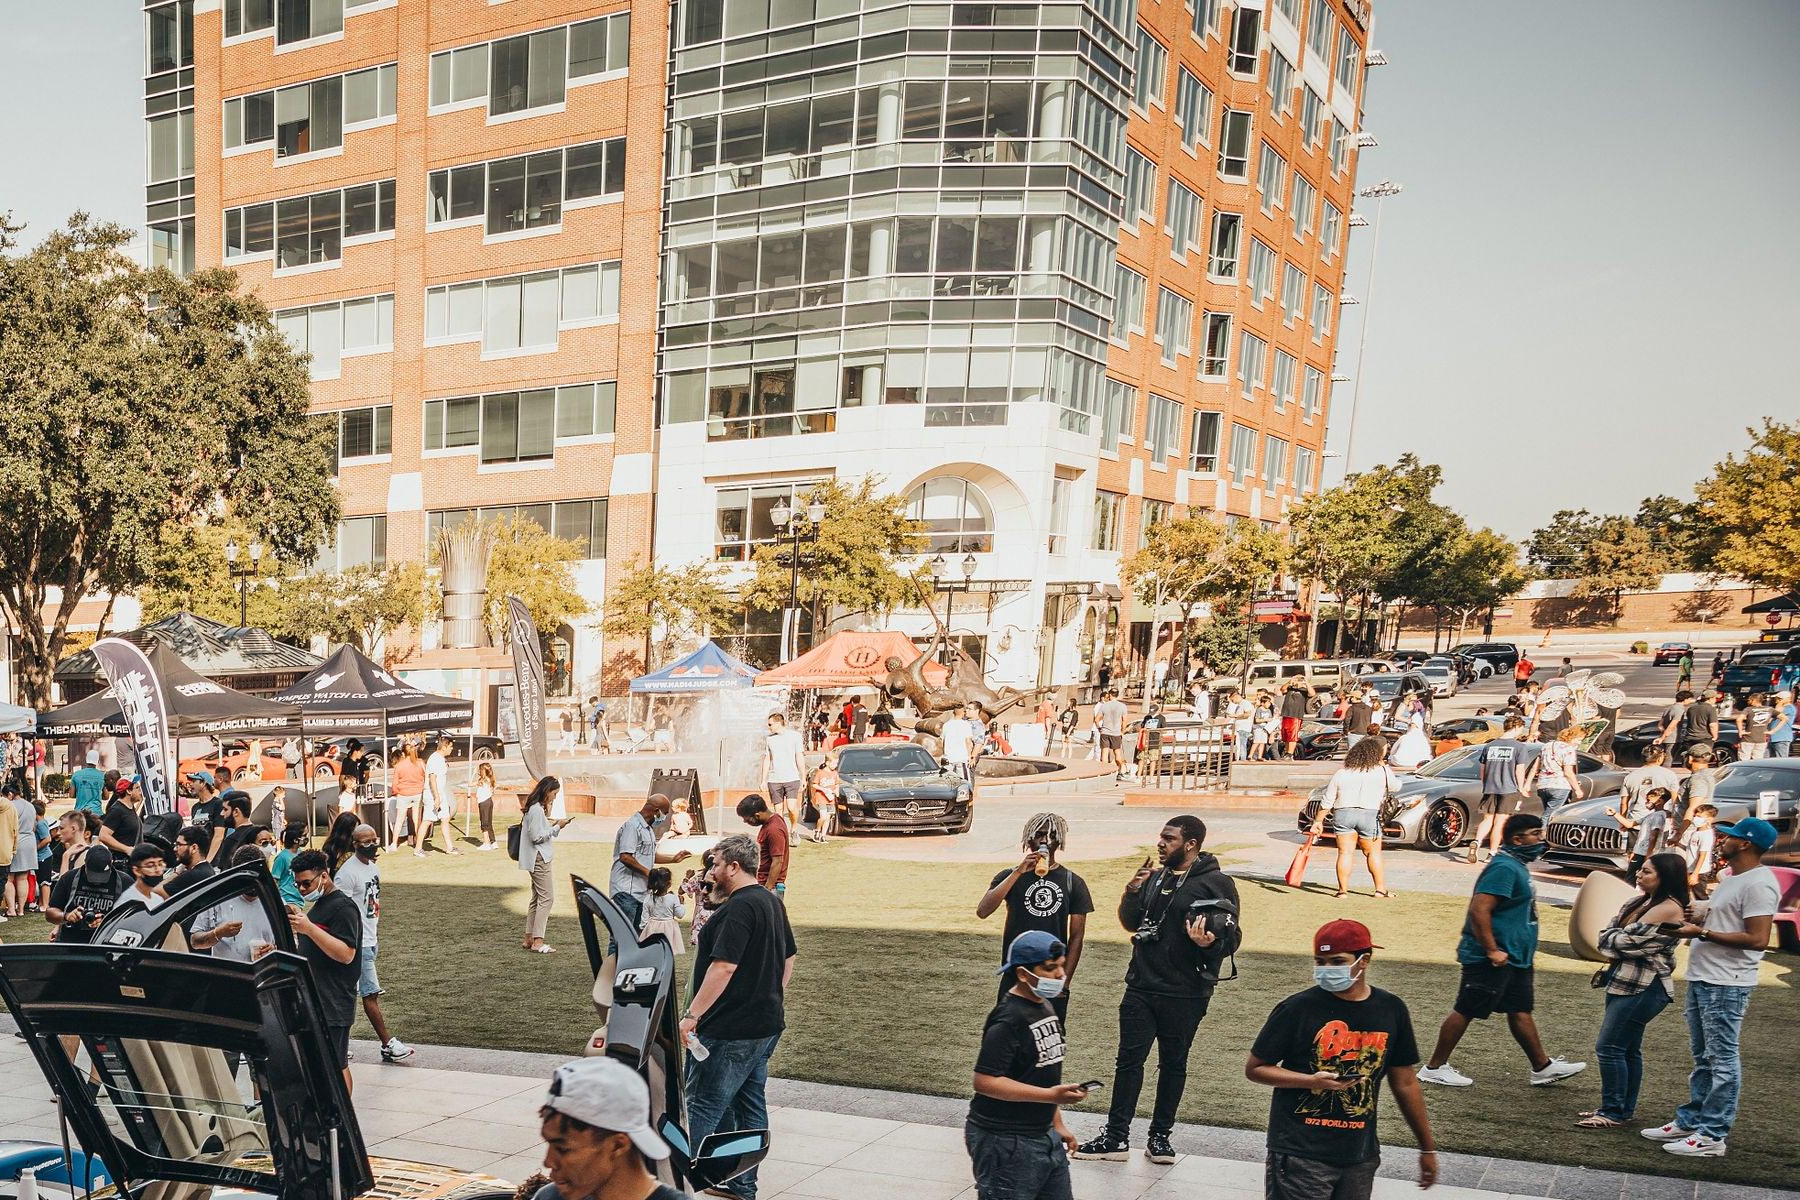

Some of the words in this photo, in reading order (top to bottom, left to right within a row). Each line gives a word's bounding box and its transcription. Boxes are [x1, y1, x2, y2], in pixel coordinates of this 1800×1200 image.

[314, 692, 351, 700] WATCH
[521, 661, 532, 751] Mercedes-Benz
[531, 699, 540, 720] Sugar
[199, 717, 288, 733] THECARCULTURE.ORG
[335, 718, 379, 727] SUPERCARS
[1304, 1117, 1321, 1126] 1972
[1321, 1118, 1348, 1129] WORLD
